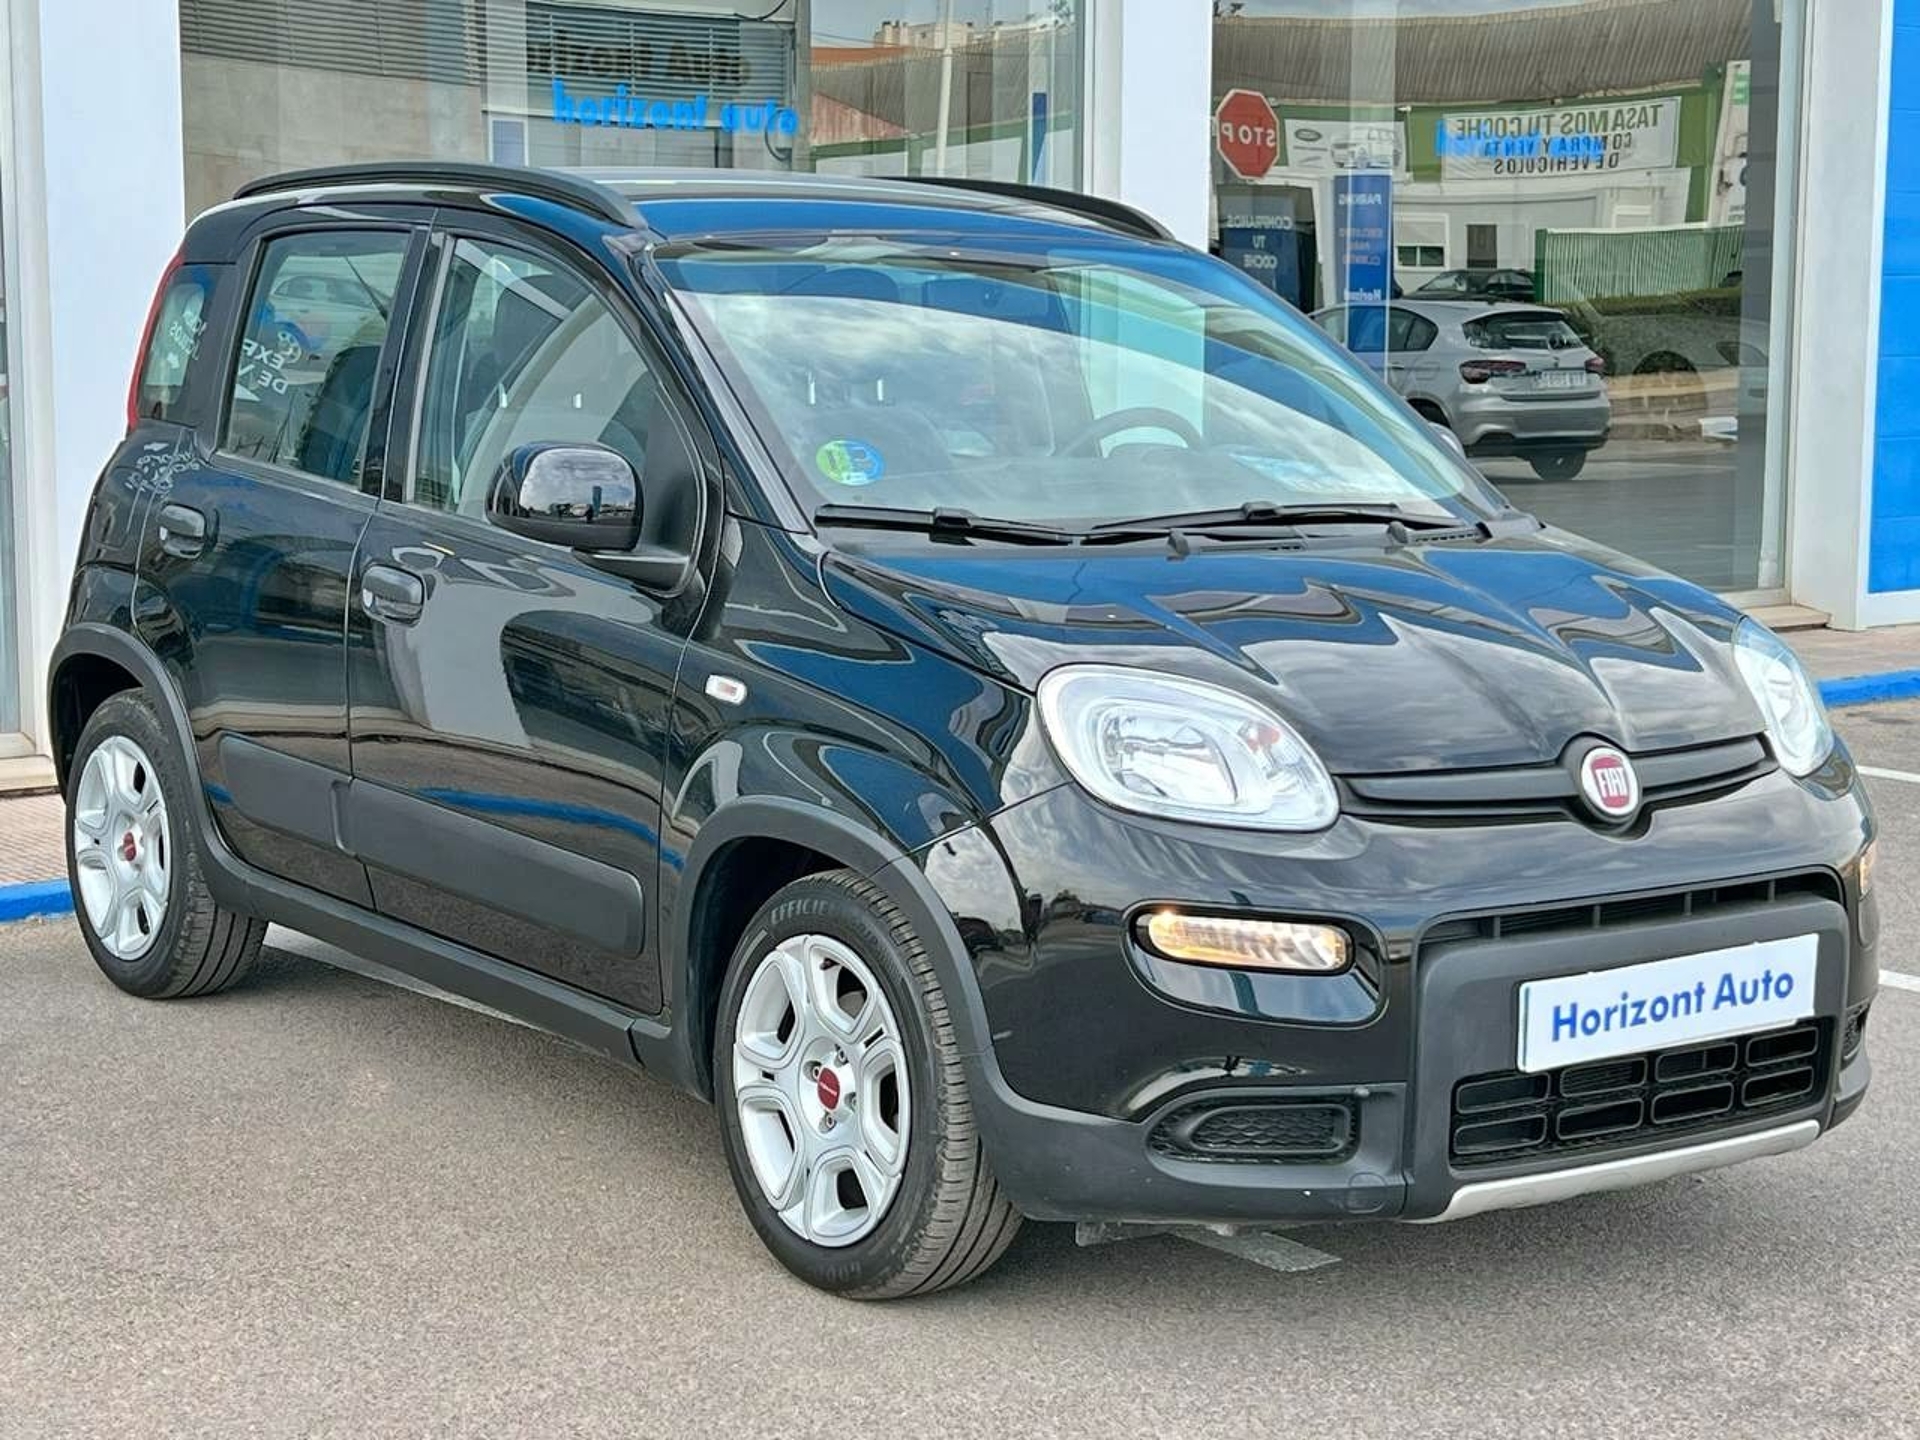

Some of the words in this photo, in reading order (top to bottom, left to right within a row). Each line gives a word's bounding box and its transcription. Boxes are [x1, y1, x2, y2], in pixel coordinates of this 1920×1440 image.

[552, 76, 708, 128] horizont
[720, 97, 799, 134] auto
[1594, 766, 1629, 798] FIAT
[1551, 980, 1706, 1042] Horizont
[1712, 969, 1794, 1011] Auto
